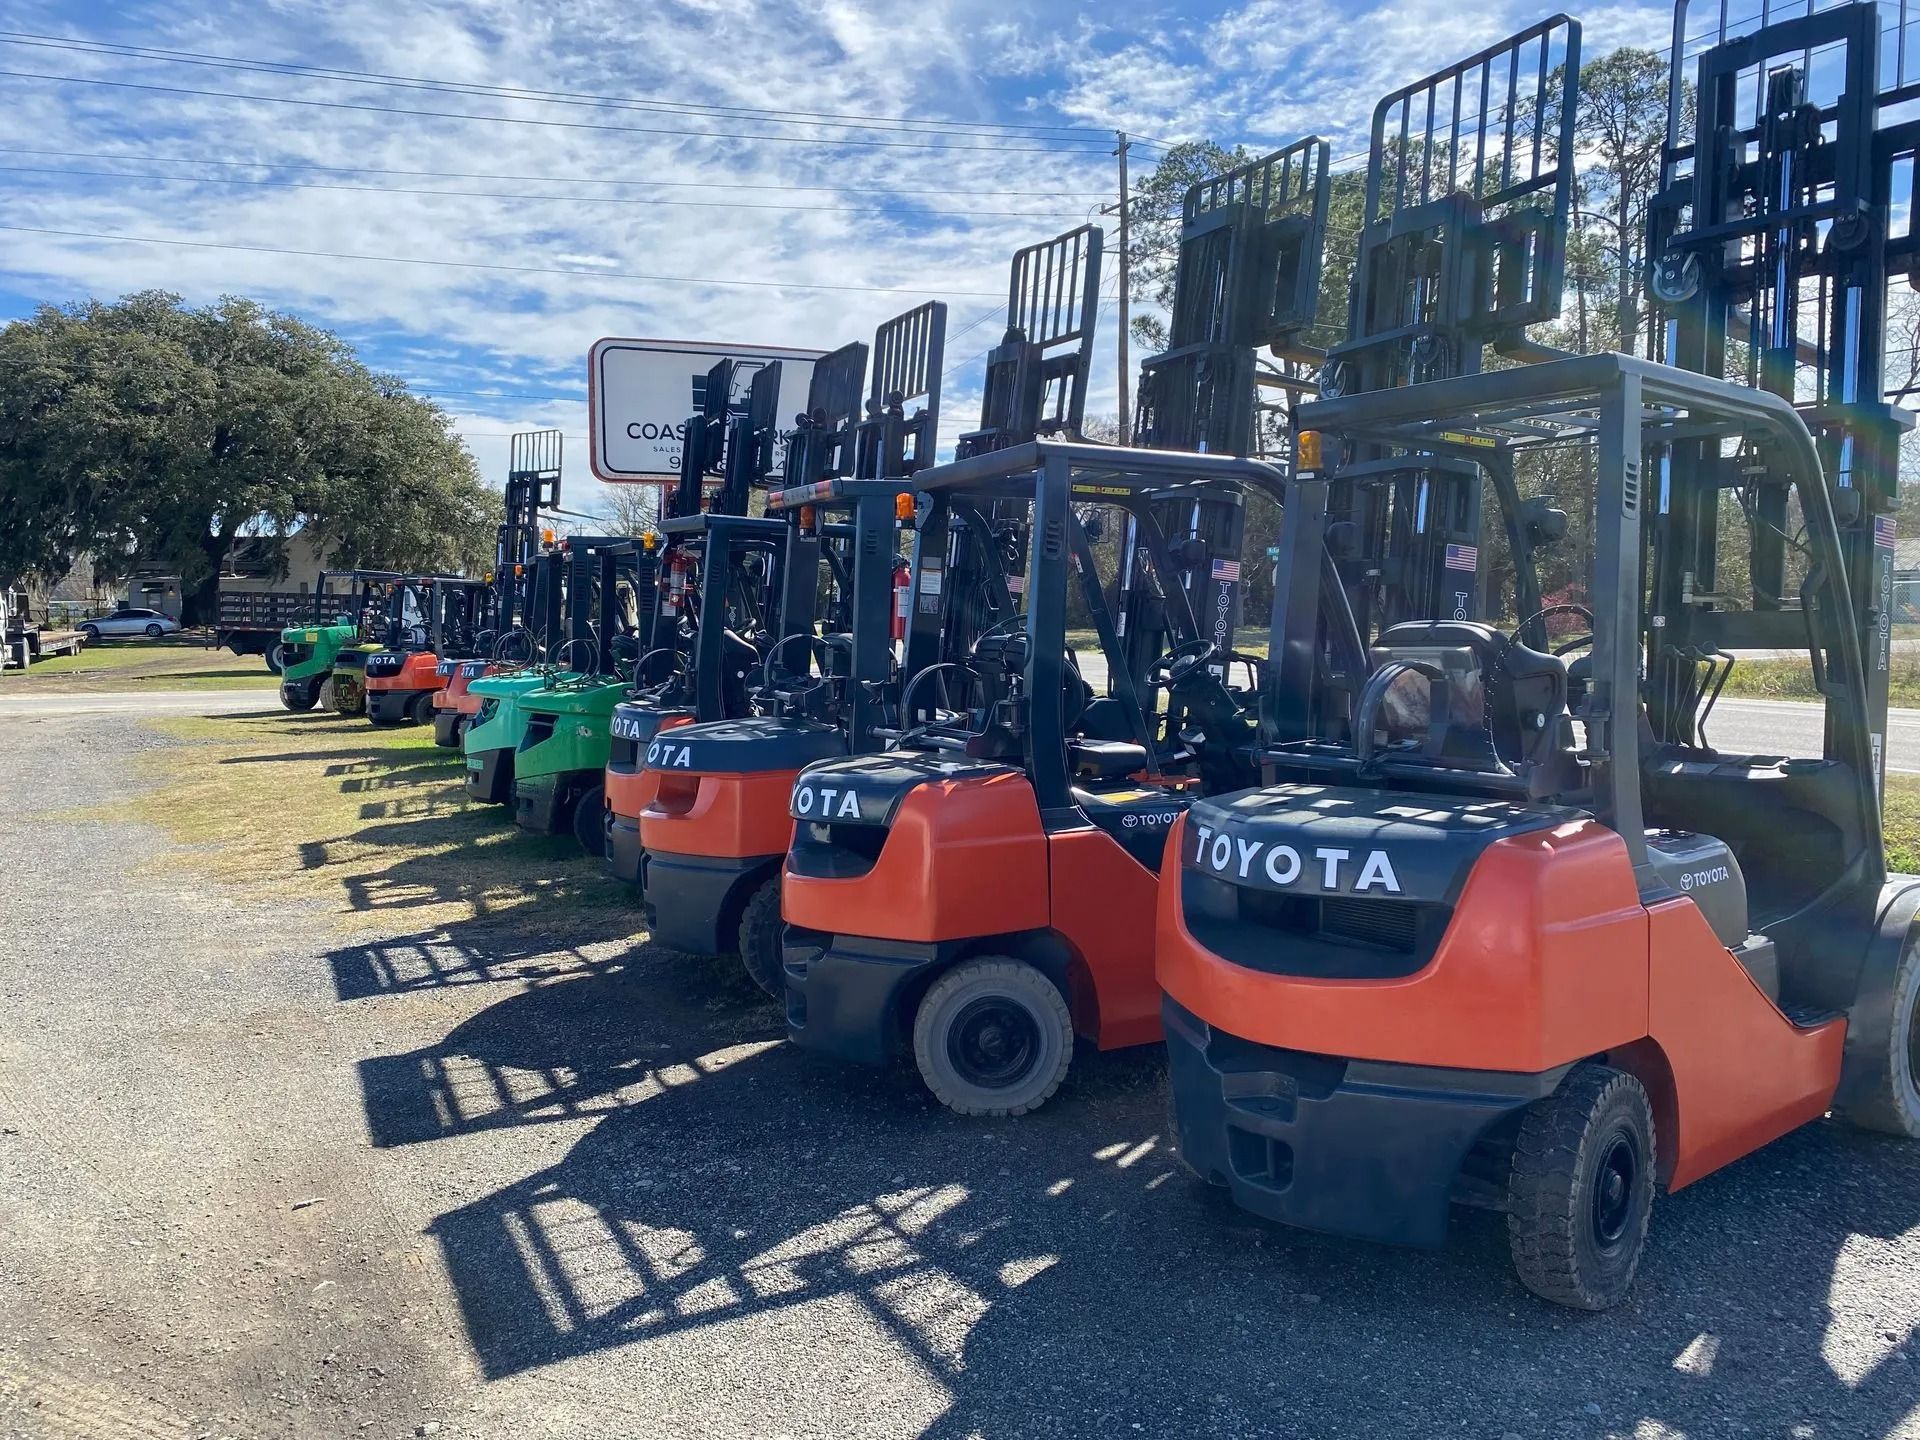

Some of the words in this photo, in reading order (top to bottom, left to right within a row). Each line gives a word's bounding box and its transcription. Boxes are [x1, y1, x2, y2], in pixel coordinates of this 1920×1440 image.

[1878, 555, 1892, 671] TOYOTA
[1195, 827, 1401, 892] TOYOTA
[1693, 866, 1729, 887] TOYOTA
